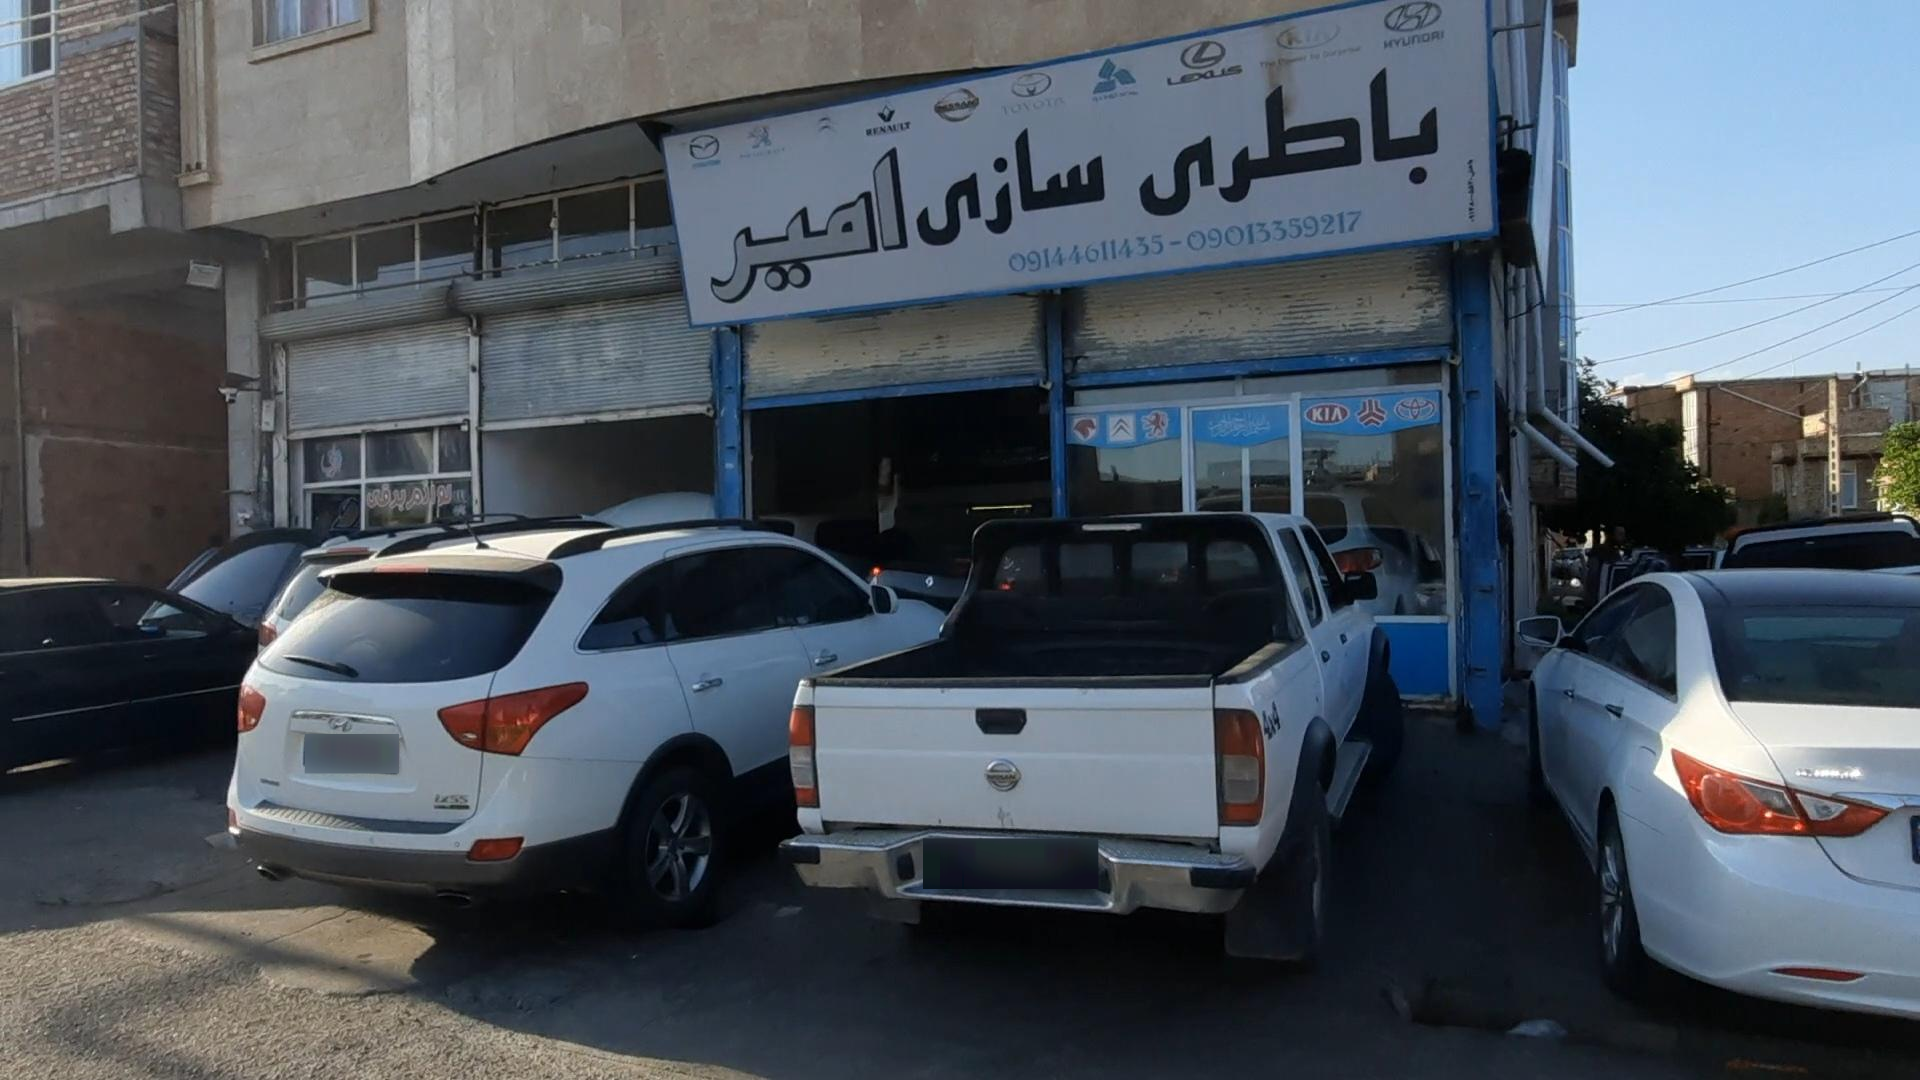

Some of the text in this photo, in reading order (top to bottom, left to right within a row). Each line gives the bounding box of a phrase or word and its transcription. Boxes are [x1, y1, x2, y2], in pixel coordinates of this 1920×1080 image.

[1383, 30, 1445, 49] HYUNDAI
[1167, 64, 1243, 86] LEXUS
[1001, 97, 1065, 116] TOYOTA
[865, 121, 911, 137] RENAULT
[1139, 67, 1439, 217] باطری
[916, 127, 1106, 247] سازی
[710, 146, 908, 304] امیر
[1312, 407, 1343, 421] KIA
